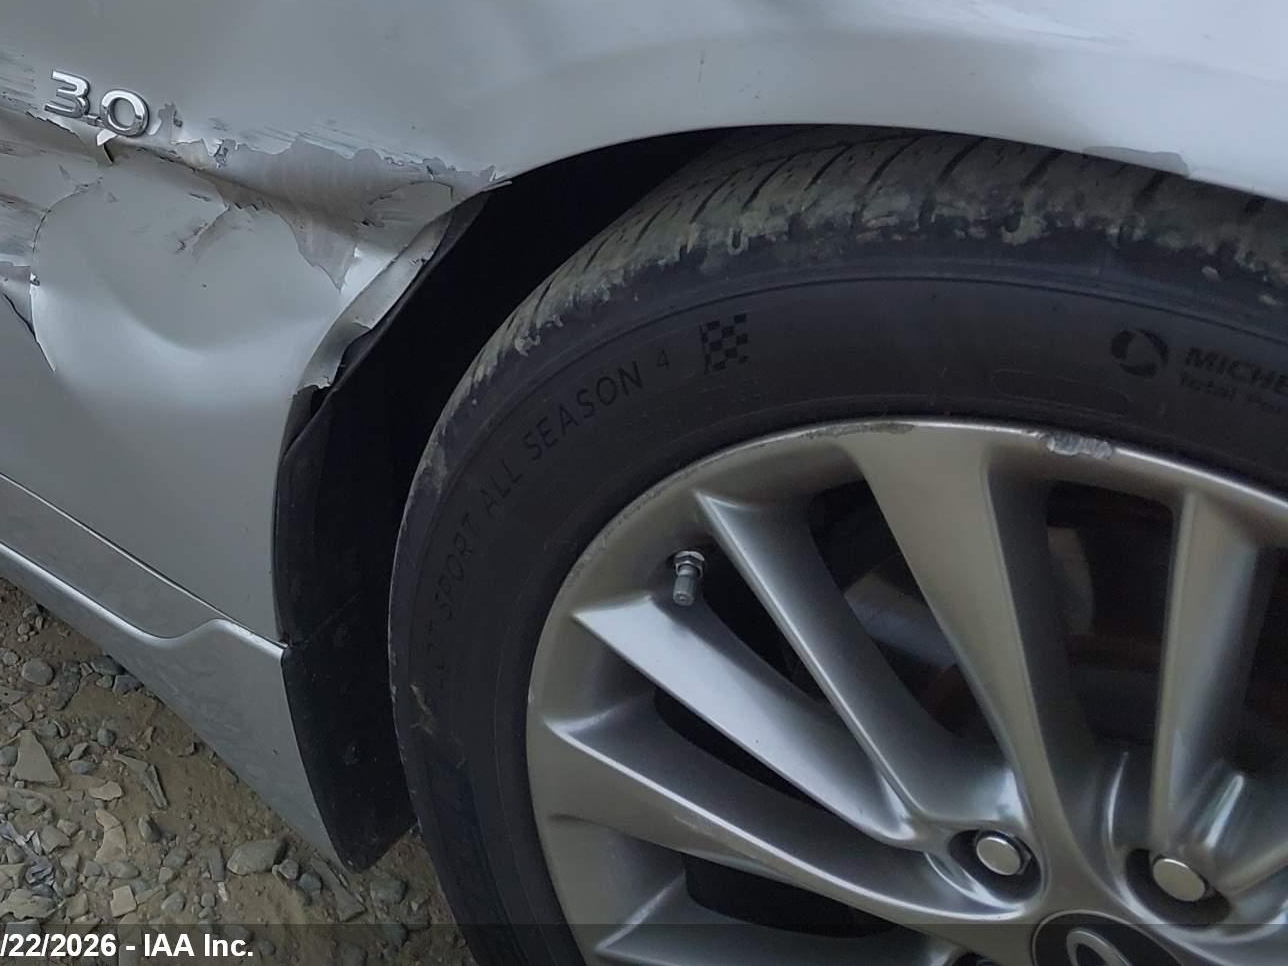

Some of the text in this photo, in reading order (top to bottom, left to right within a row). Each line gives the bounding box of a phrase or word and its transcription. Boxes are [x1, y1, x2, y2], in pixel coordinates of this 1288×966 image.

[44, 69, 151, 138] 3.0
[433, 512, 482, 620] SPORT
[479, 459, 524, 517] ALL
[521, 359, 645, 462] SEASON
[655, 348, 672, 371] 4
